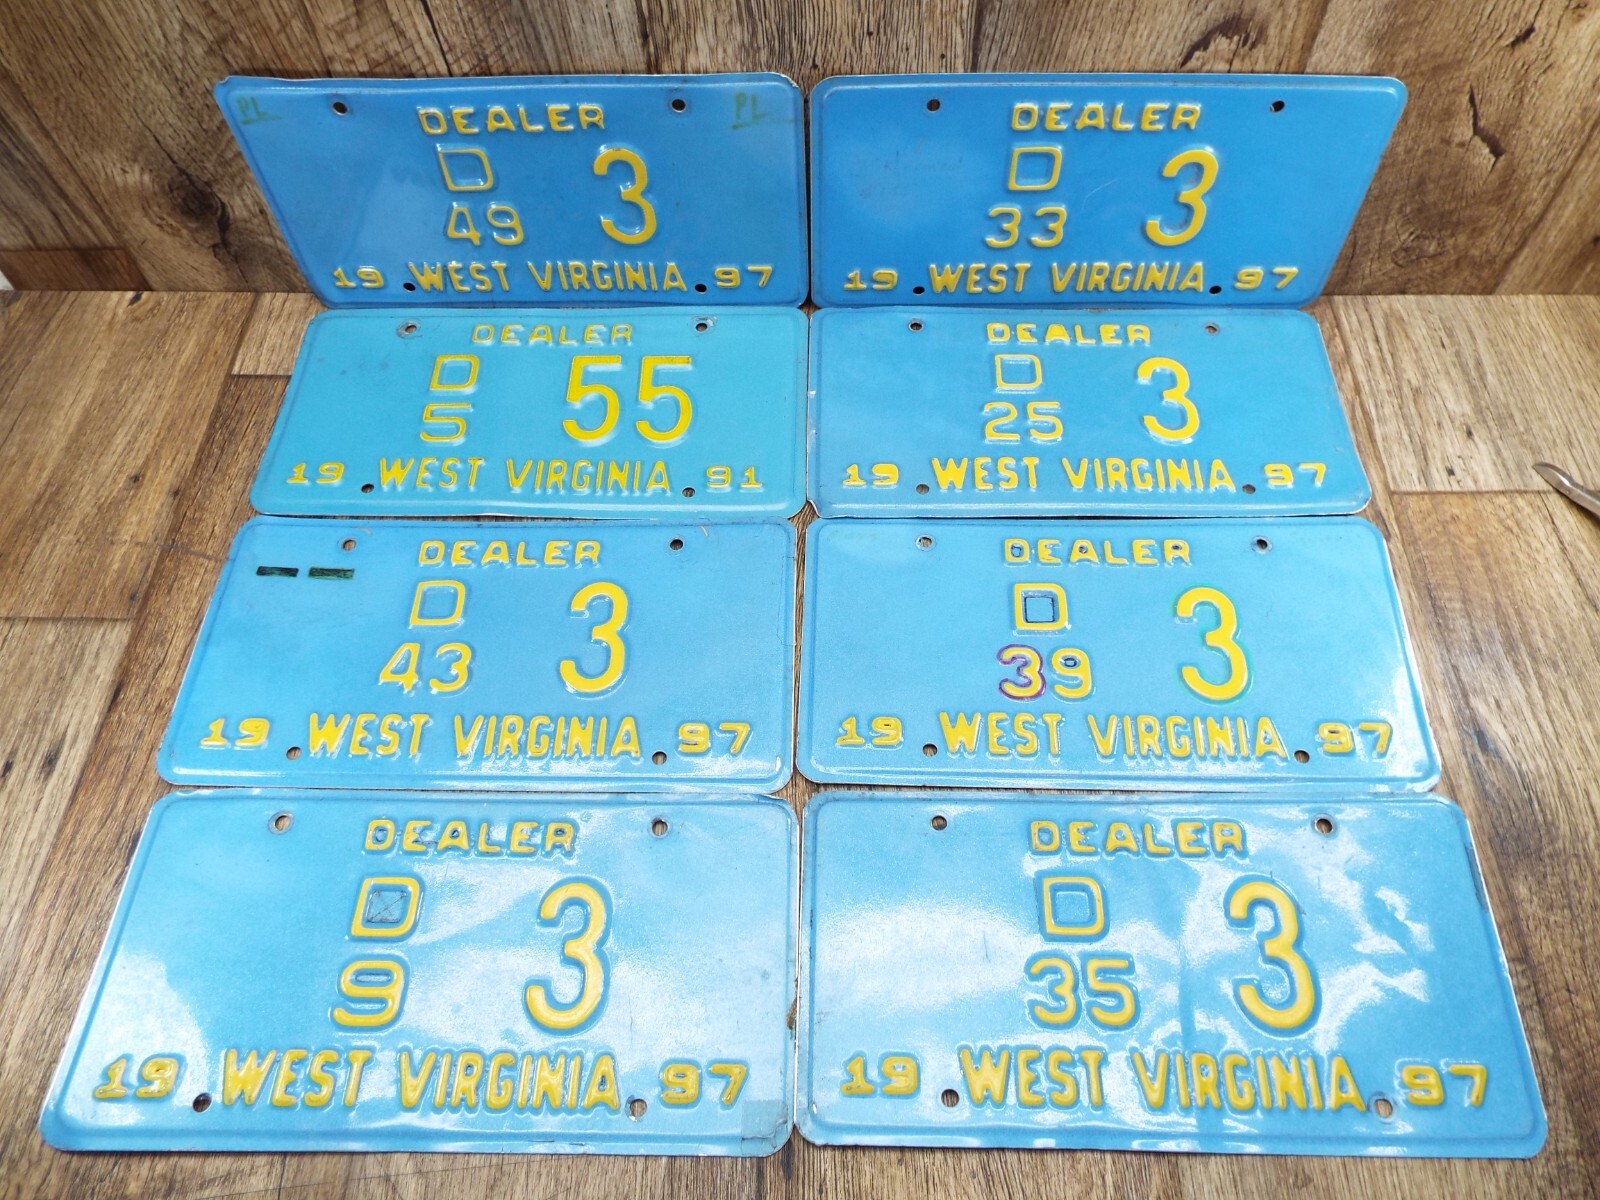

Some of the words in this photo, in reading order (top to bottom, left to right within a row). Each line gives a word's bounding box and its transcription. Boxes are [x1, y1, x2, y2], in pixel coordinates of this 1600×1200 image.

[418, 104, 605, 135] DEALER
[1011, 103, 1201, 132] DEALER
[592, 147, 657, 246] 3
[1144, 148, 1220, 247] 3
[446, 205, 525, 246] 49
[986, 206, 1067, 249] 33
[333, 268, 385, 289] 19
[408, 261, 509, 293] WEST
[528, 261, 687, 292] VIRGINIA
[714, 265, 773, 289] 97
[844, 269, 899, 291] 19
[928, 262, 1031, 294] WEST
[1050, 262, 1204, 293] VIRGINIA
[1235, 267, 1299, 291] 97
[471, 323, 633, 345] DEALER
[985, 321, 1152, 345] DEALER
[561, 353, 694, 444] 55
[1136, 356, 1201, 443] 3
[419, 401, 472, 444] 5
[983, 400, 1064, 442] 25
[286, 461, 346, 485] 19
[379, 456, 486, 489] WEST
[505, 458, 671, 492] VIRGINIA
[705, 464, 763, 490] 91
[842, 462, 900, 487] 19
[930, 455, 1040, 491] WEST
[1061, 456, 1236, 491] VIRGINIA
[1263, 461, 1328, 487] 97
[418, 540, 601, 566] DEALER
[1003, 538, 1190, 565] DEALER
[559, 581, 629, 693] 3
[1175, 586, 1248, 701] 3
[379, 642, 473, 693] 43
[1002, 647, 1092, 699] 39
[200, 717, 270, 747] 19
[308, 713, 430, 756] WEST
[453, 714, 641, 758] VIRGINIA
[677, 722, 751, 755] 97
[836, 716, 903, 746] 19
[938, 711, 1062, 756] WEST
[1087, 714, 1287, 759] VIRGINIA
[1318, 722, 1392, 754] 97
[365, 819, 574, 854] DEALER
[1030, 820, 1242, 855] DEALER
[525, 882, 606, 1030] 3
[1229, 881, 1316, 1030] 3
[332, 960, 404, 1028] 9
[1030, 957, 1136, 1027] 35
[93, 1058, 178, 1100] 19
[221, 1049, 372, 1108] WEST
[399, 1051, 620, 1111] VIRGINIA
[661, 1063, 747, 1105] 97
[840, 1056, 919, 1096] 19
[960, 1049, 1104, 1107] WEST
[1133, 1052, 1367, 1113] VIRGINIA
[1401, 1064, 1488, 1107] 97
